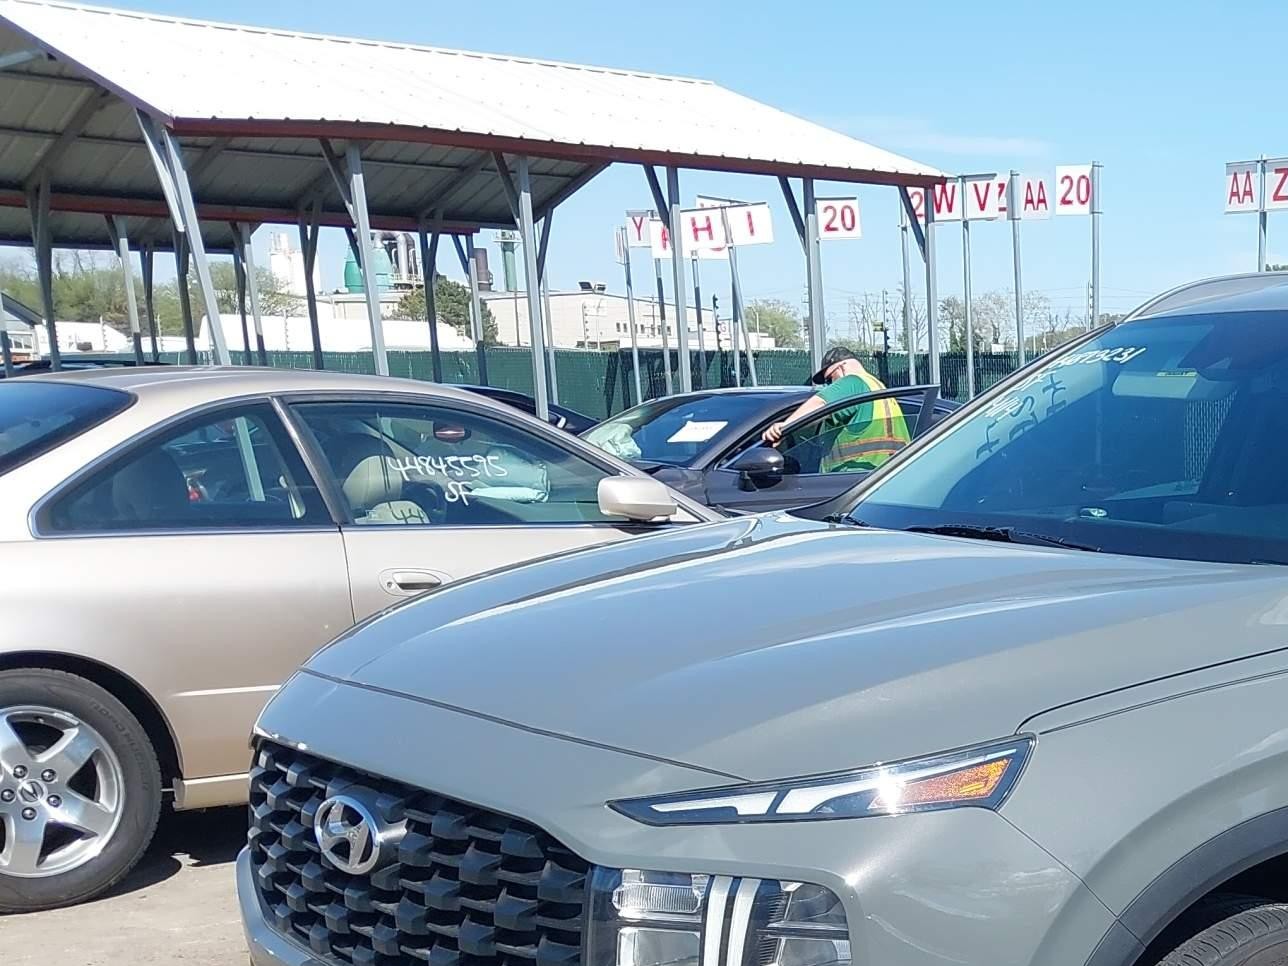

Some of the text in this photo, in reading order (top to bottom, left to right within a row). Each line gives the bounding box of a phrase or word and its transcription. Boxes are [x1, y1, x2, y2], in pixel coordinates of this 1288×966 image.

[932, 182, 955, 214] W
[973, 182, 990, 211] V
[1023, 180, 1048, 211] AA
[1059, 174, 1091, 206] 20
[1229, 171, 1254, 204] AA
[632, 216, 644, 241] Y
[690, 215, 714, 242] H
[823, 204, 856, 233] 20
[385, 454, 508, 482] 44845595
